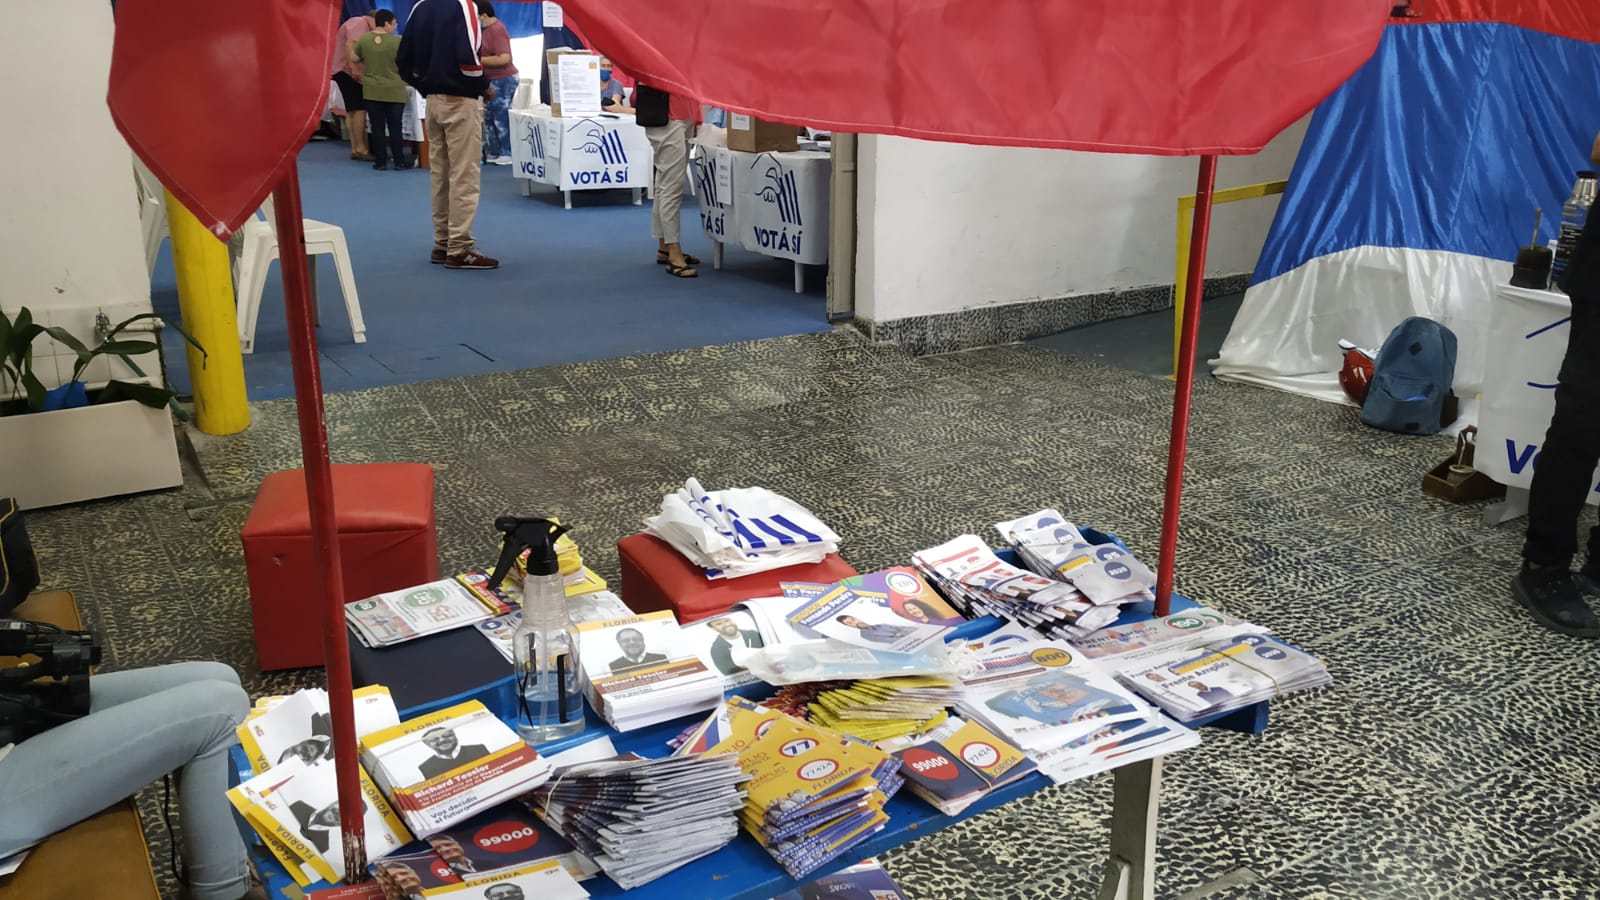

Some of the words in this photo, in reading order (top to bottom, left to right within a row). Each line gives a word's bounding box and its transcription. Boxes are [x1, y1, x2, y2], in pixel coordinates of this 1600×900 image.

[570, 168, 612, 185] VOTÁ
[615, 166, 629, 183] SÍ
[700, 210, 714, 234] TÁ
[715, 212, 725, 235] SÍ
[754, 227, 790, 252] VOTÁ
[792, 230, 803, 255] SÍ
[602, 617, 645, 628] FLORIDA
[1172, 618, 1200, 630] 190
[1036, 651, 1067, 662] 800
[404, 715, 451, 735] FLORIDA
[784, 741, 810, 755] 77
[912, 756, 948, 772] 99000
[414, 779, 453, 799] Richard
[453, 764, 489, 782] Tessier
[813, 766, 856, 791] FLORIDA
[361, 779, 390, 818] FLORIDA
[430, 808, 447, 819] Vos
[442, 805, 471, 821] futuro
[277, 825, 316, 860] FLORIDA
[480, 827, 535, 847] 99000
[465, 871, 521, 888] FLORIDA
